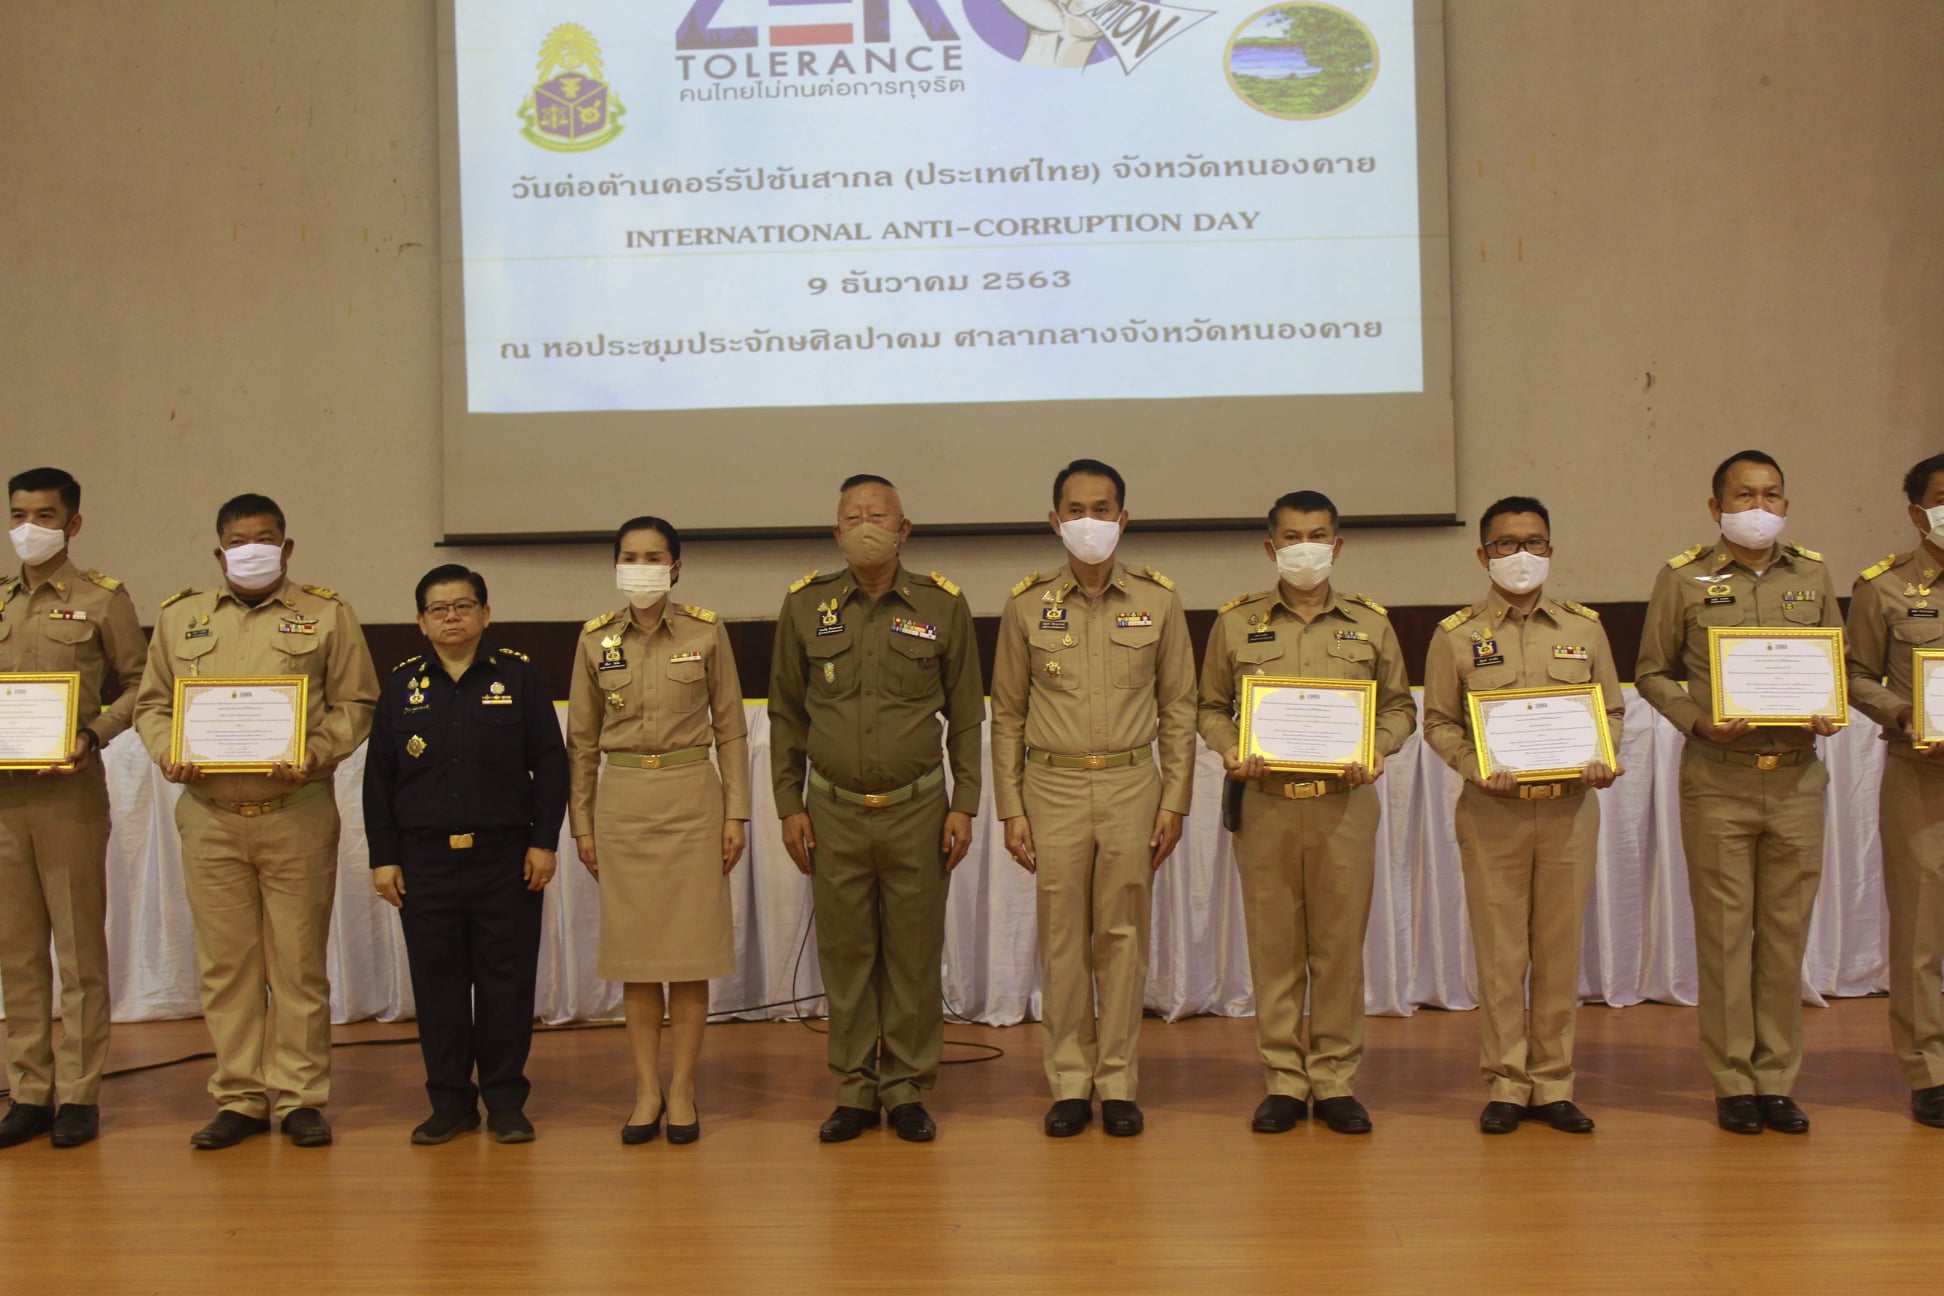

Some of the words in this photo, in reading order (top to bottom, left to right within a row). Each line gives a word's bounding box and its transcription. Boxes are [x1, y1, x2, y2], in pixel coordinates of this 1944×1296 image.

[674, 46, 963, 81] TOLERANCE
[679, 75, 965, 102] คนไทยไม่ทนต่อการทุจริต
[512, 166, 894, 199] วันต่อต้านคอร์รัปชันสากล
[904, 157, 1101, 191] (ประเทศไทย)
[1112, 153, 1376, 179] จังหวัดหนองคาย
[626, 222, 872, 248] INTERNATIONAL
[881, 213, 1182, 240] ANTI-CORRUPTION
[1193, 211, 1261, 232] DAY
[808, 277, 828, 296] 9
[841, 269, 969, 294] ธันวาคม
[982, 270, 1071, 291] 2563
[501, 343, 531, 359] ณ
[543, 326, 941, 362] หอประชุมประจักษศิลปาคม
[954, 317, 1383, 348] ศาลากลางจังหวัดหนองคาย
